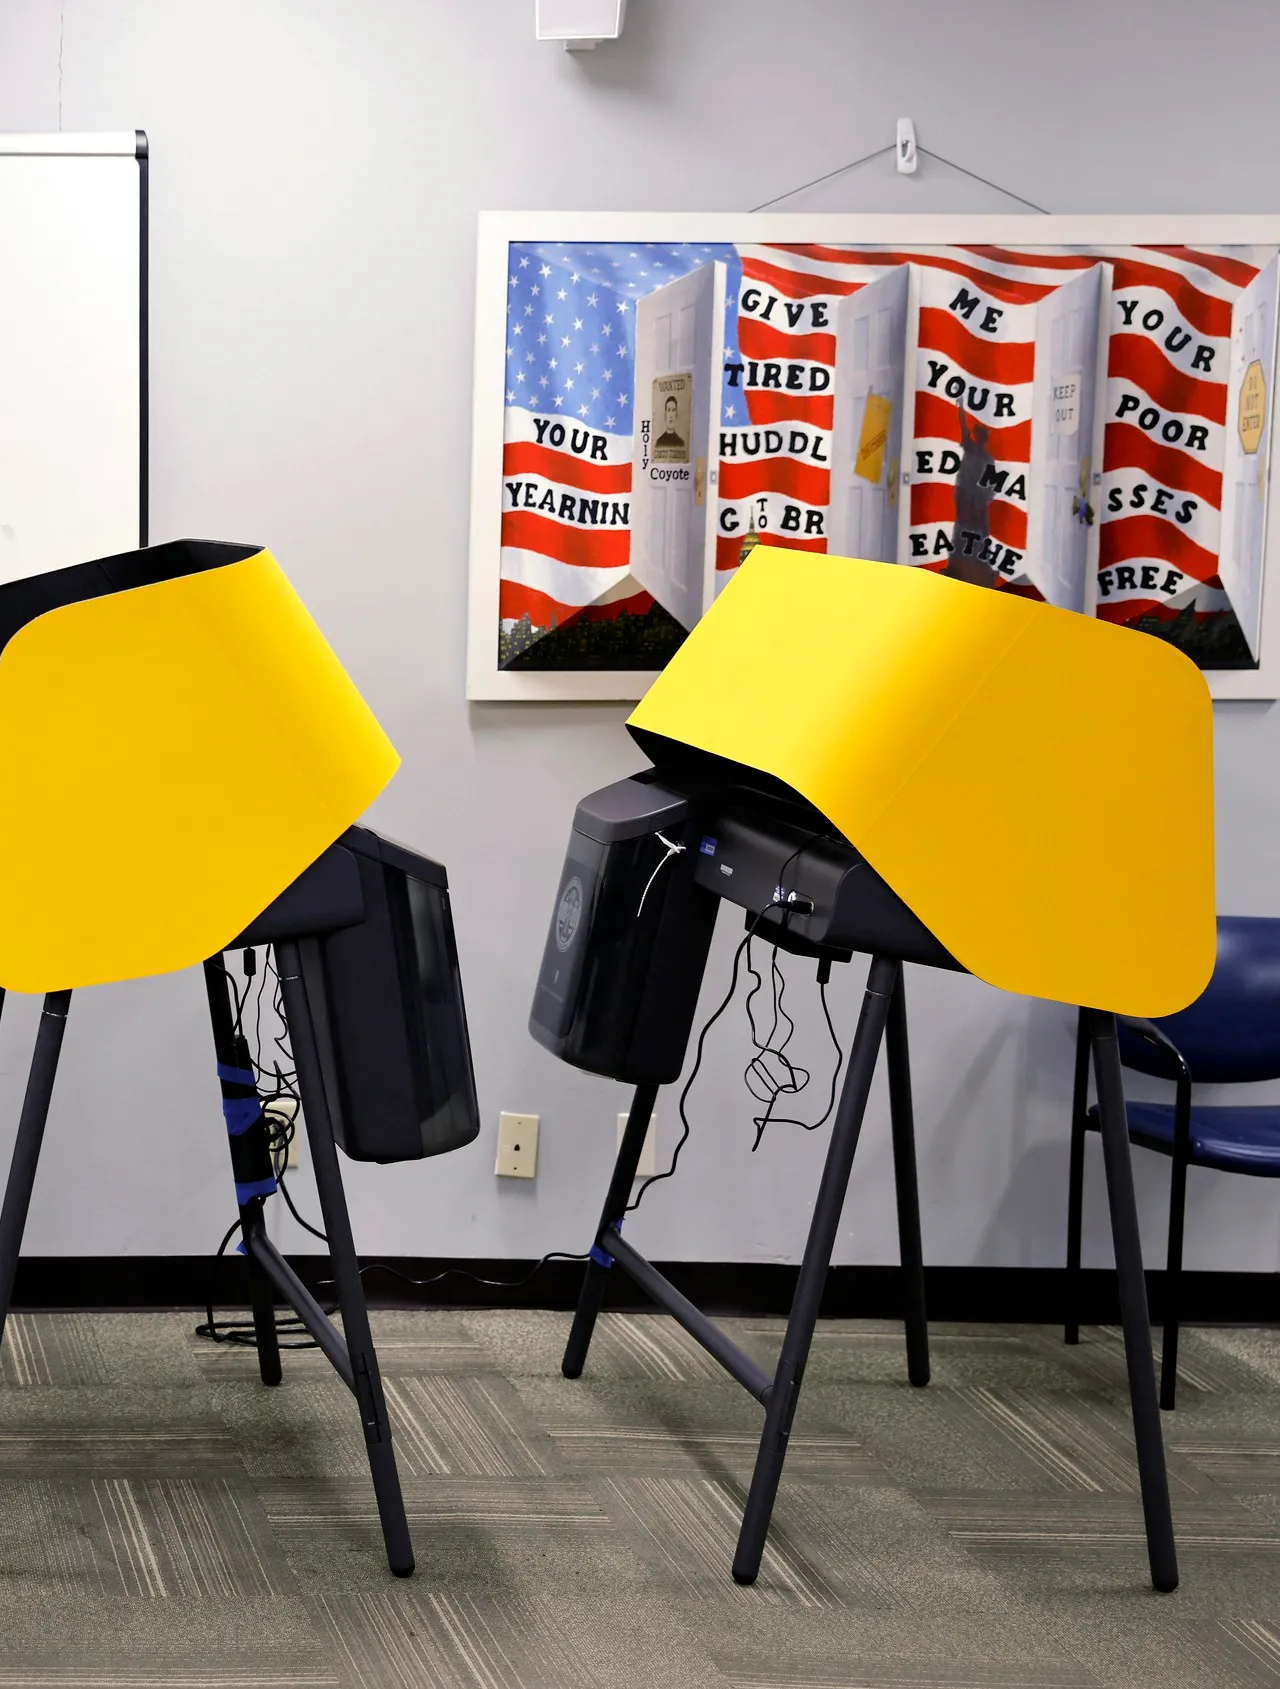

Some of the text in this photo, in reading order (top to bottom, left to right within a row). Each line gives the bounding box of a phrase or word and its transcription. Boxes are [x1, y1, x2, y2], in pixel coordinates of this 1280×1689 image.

[740, 288, 1217, 373] GIVE ME YOUR
[658, 378, 686, 392] WANTED
[724, 360, 1209, 451] TIRED YOUR POOR
[1053, 384, 1076, 401] KEEP
[1055, 408, 1074, 422] OUT
[532, 417, 609, 462] YOUR
[719, 430, 829, 462] HUDDL
[915, 450, 962, 475] ED
[978, 463, 1027, 501] MA
[1107, 483, 1199, 525] SSES
[650, 467, 690, 482] Coyote
[505, 481, 630, 526] YEARNIN
[719, 507, 740, 533] G
[780, 505, 825, 536] BR
[1096, 565, 1184, 598] FREE
